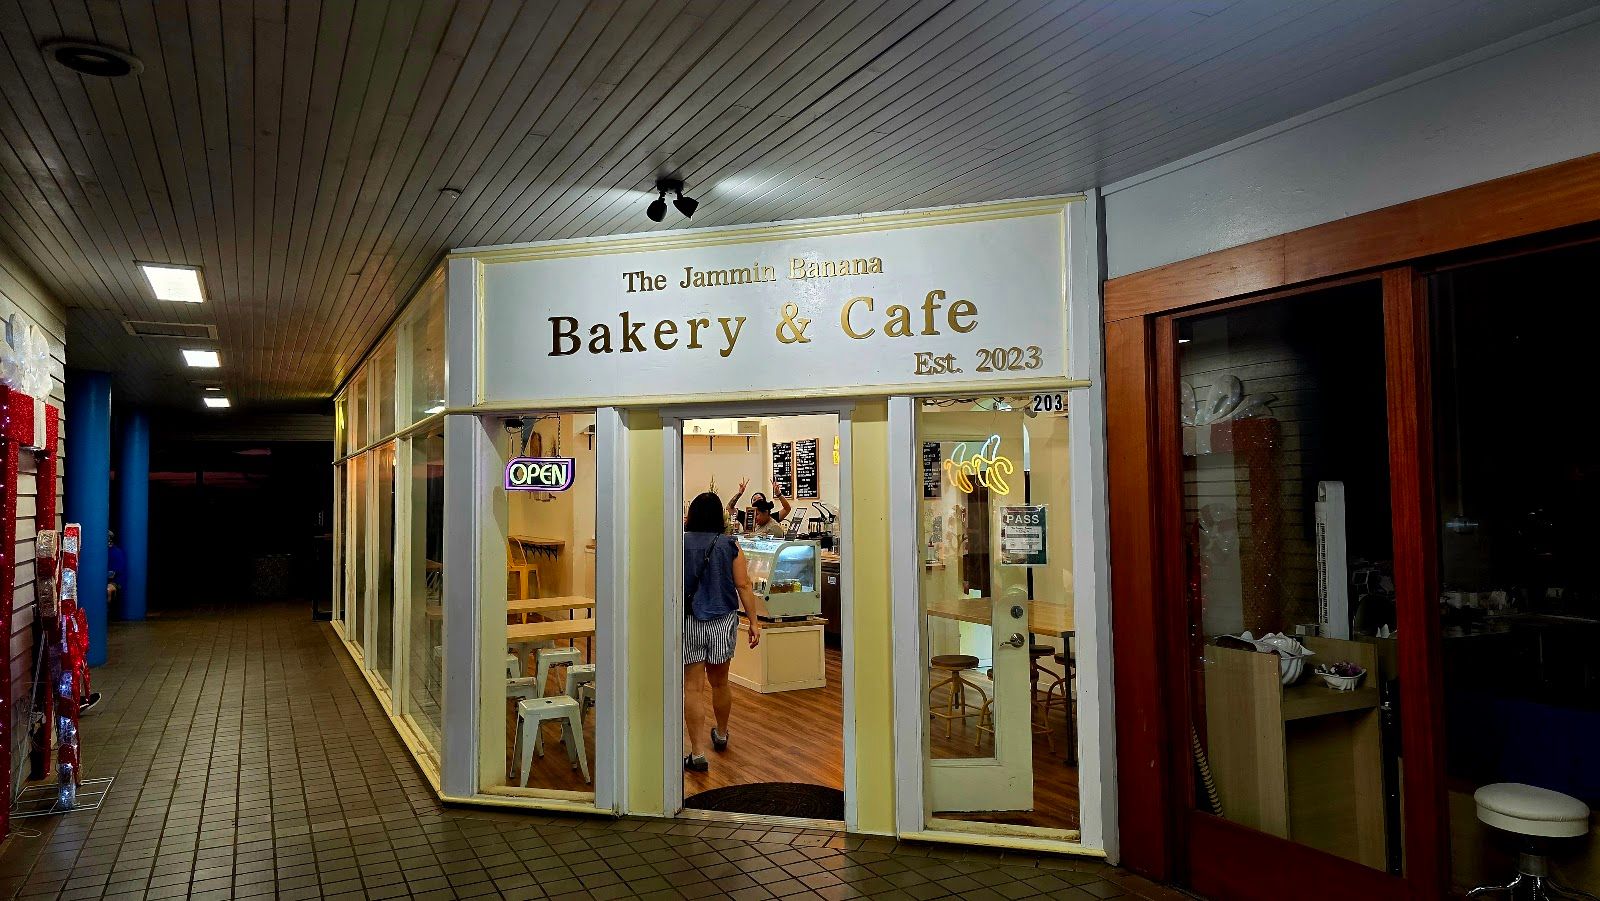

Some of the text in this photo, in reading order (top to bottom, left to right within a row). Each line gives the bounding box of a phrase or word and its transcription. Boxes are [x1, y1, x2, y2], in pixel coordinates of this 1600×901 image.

[622, 256, 885, 293] The Jammin Banana
[547, 289, 979, 358] Bakery & Cafe
[913, 345, 1044, 375] Est. 2023
[1033, 394, 1064, 412] 203
[509, 463, 567, 486] OPEN
[1006, 514, 1040, 524] PASS
